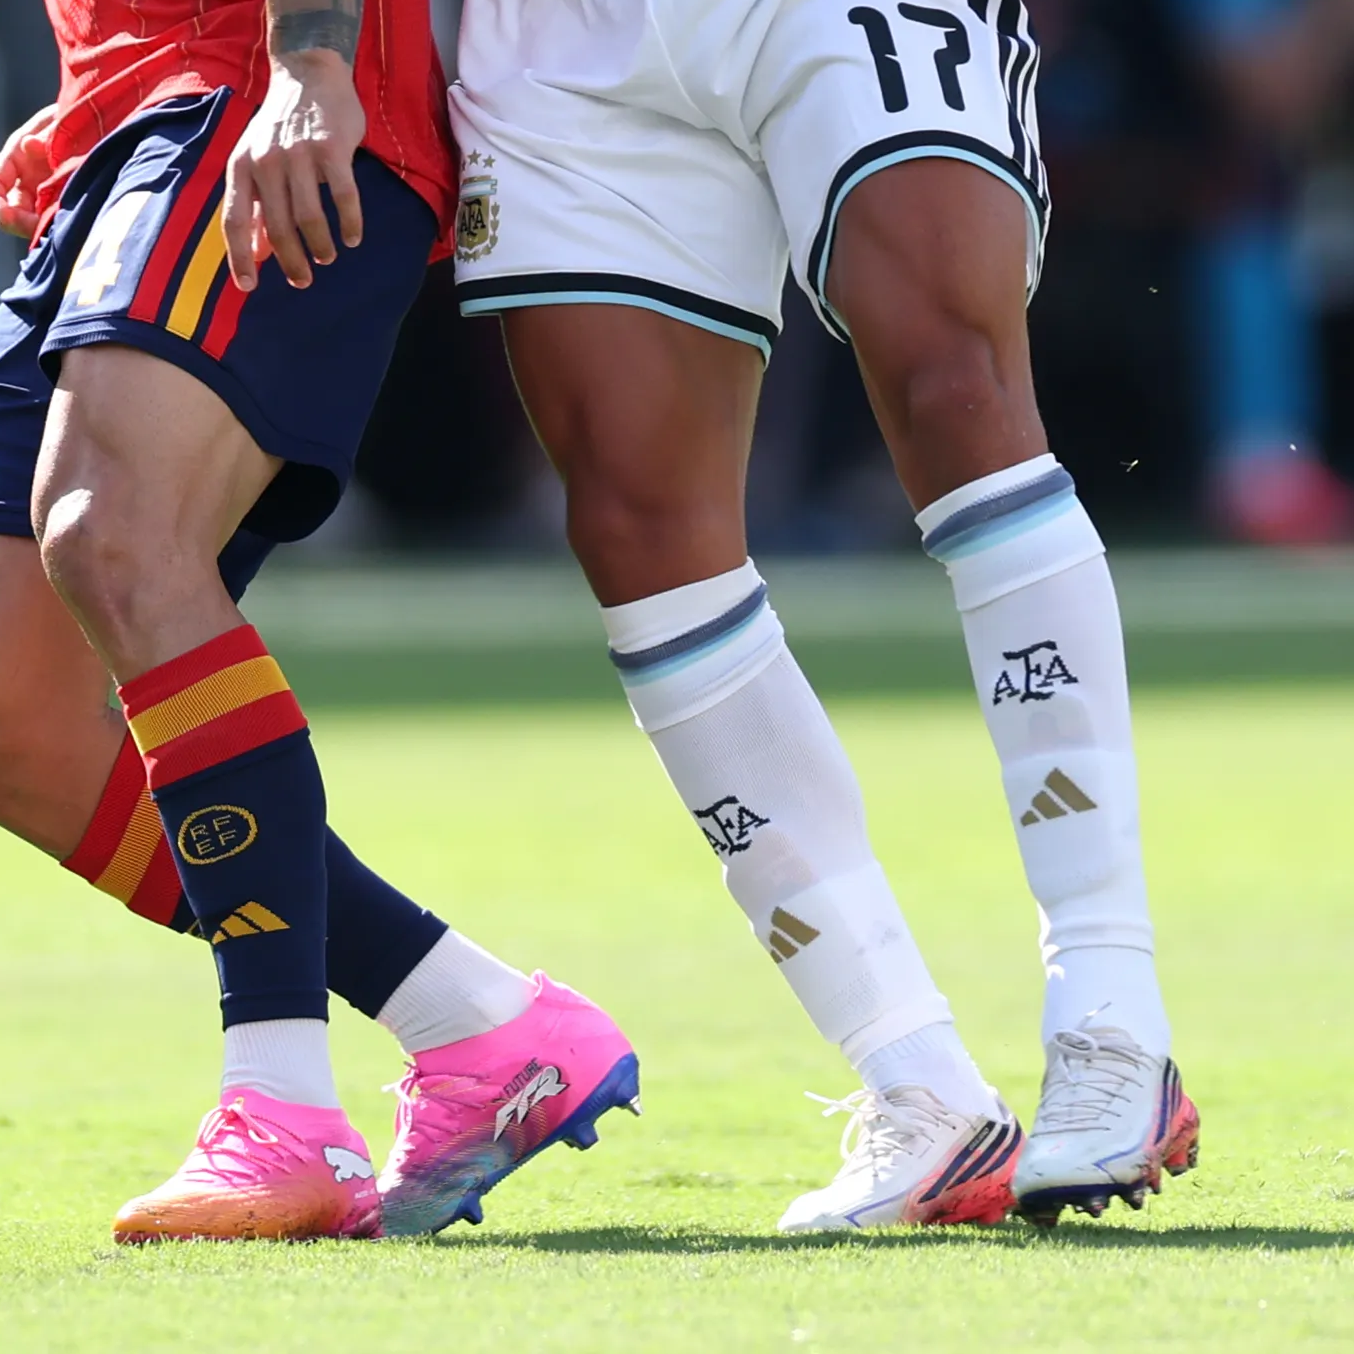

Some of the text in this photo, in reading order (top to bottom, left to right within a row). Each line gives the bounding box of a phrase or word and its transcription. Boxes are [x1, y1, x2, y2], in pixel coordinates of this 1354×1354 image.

[847, 1, 972, 114] 17
[992, 639, 1079, 706] AFA
[503, 1057, 543, 1099] FUTURE
